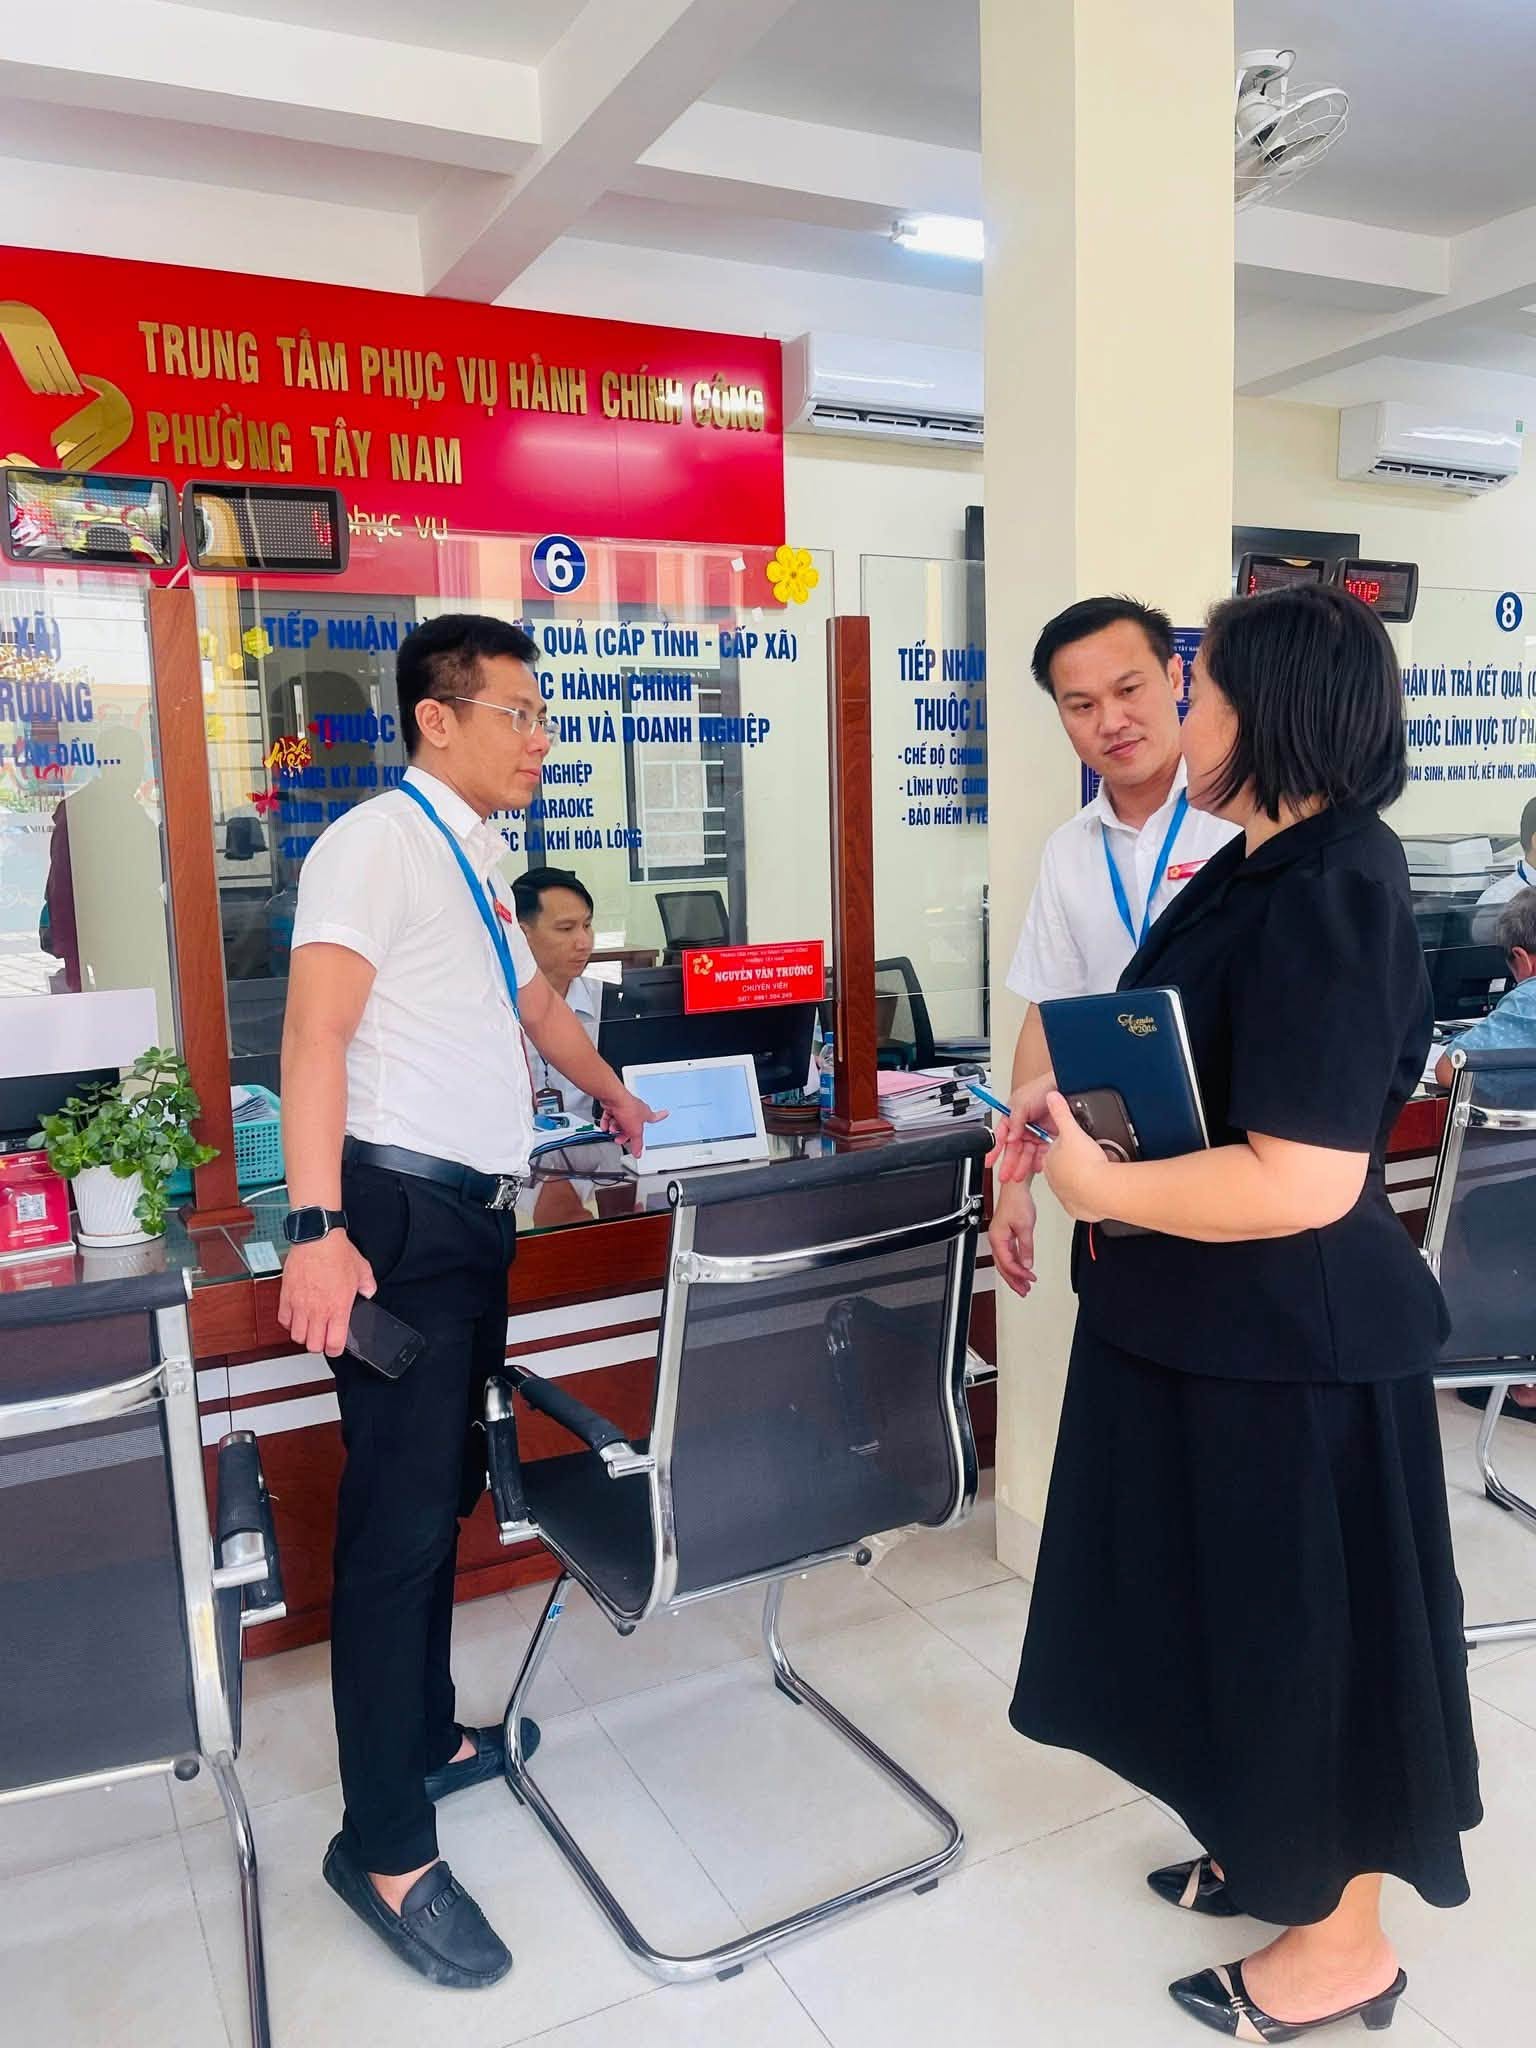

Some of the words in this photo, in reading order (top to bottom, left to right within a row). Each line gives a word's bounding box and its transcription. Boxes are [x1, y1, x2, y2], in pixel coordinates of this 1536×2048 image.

[138, 320, 259, 385] TRUNG
[276, 328, 349, 392] TÂM
[361, 345, 445, 409] PHỤC
[457, 355, 498, 417] VỤ
[509, 352, 588, 415] HÀNH
[601, 363, 684, 425] CHÍNH
[692, 371, 765, 431] CÔNG
[146, 403, 293, 473] PHƯỜNG
[311, 416, 372, 478] TÂY
[390, 433, 463, 485] NAM
[414, 515, 448, 546] vụ
[545, 543, 573, 588] 6
[1502, 597, 1516, 628] 8
[263, 610, 319, 650] TIẾP
[329, 614, 398, 655] NHẬN
[543, 618, 588, 657] QUẢ
[595, 620, 645, 658] (CẤP
[652, 622, 698, 658] TỈNH
[720, 624, 757, 659] CẤP
[765, 628, 798, 661] XÃ)
[898, 639, 936, 681] TIẾP
[562, 667, 621, 701] HÀNH
[629, 670, 692, 702] CHÍNH
[1400, 663, 1428, 702] HẬN
[1432, 664, 1446, 697] VÀ
[1451, 660, 1472, 697] TRẢ
[1476, 663, 1498, 697] KẾT
[1501, 661, 1523, 700] QUẢ
[314, 708, 395, 749] THUỘC
[588, 710, 616, 743] VÀ
[624, 716, 692, 743] DOANH
[699, 713, 771, 748] NGHIỆP
[914, 691, 970, 737] THUỘC
[1407, 713, 1441, 752] HUỘC
[1445, 715, 1473, 746] LĨNH
[1476, 716, 1498, 751] VỰC
[1502, 716, 1517, 745] TƯ
[1520, 718, 1536, 745] PH
[542, 760, 593, 787] NGHIỆP
[904, 741, 927, 765] CHẾ
[930, 743, 945, 768] ĐỘ
[1407, 765, 1422, 780] HAI
[1447, 765, 1466, 780] KHAI
[1481, 761, 1496, 780] KẾT
[907, 775, 933, 796] LĨNH
[936, 775, 958, 798] VỰC
[531, 798, 594, 819] KARAOKE
[908, 802, 931, 826] BẢO
[934, 800, 963, 824] HIỂM
[546, 826, 570, 851] KHÍ
[607, 822, 642, 848] LỎNG
